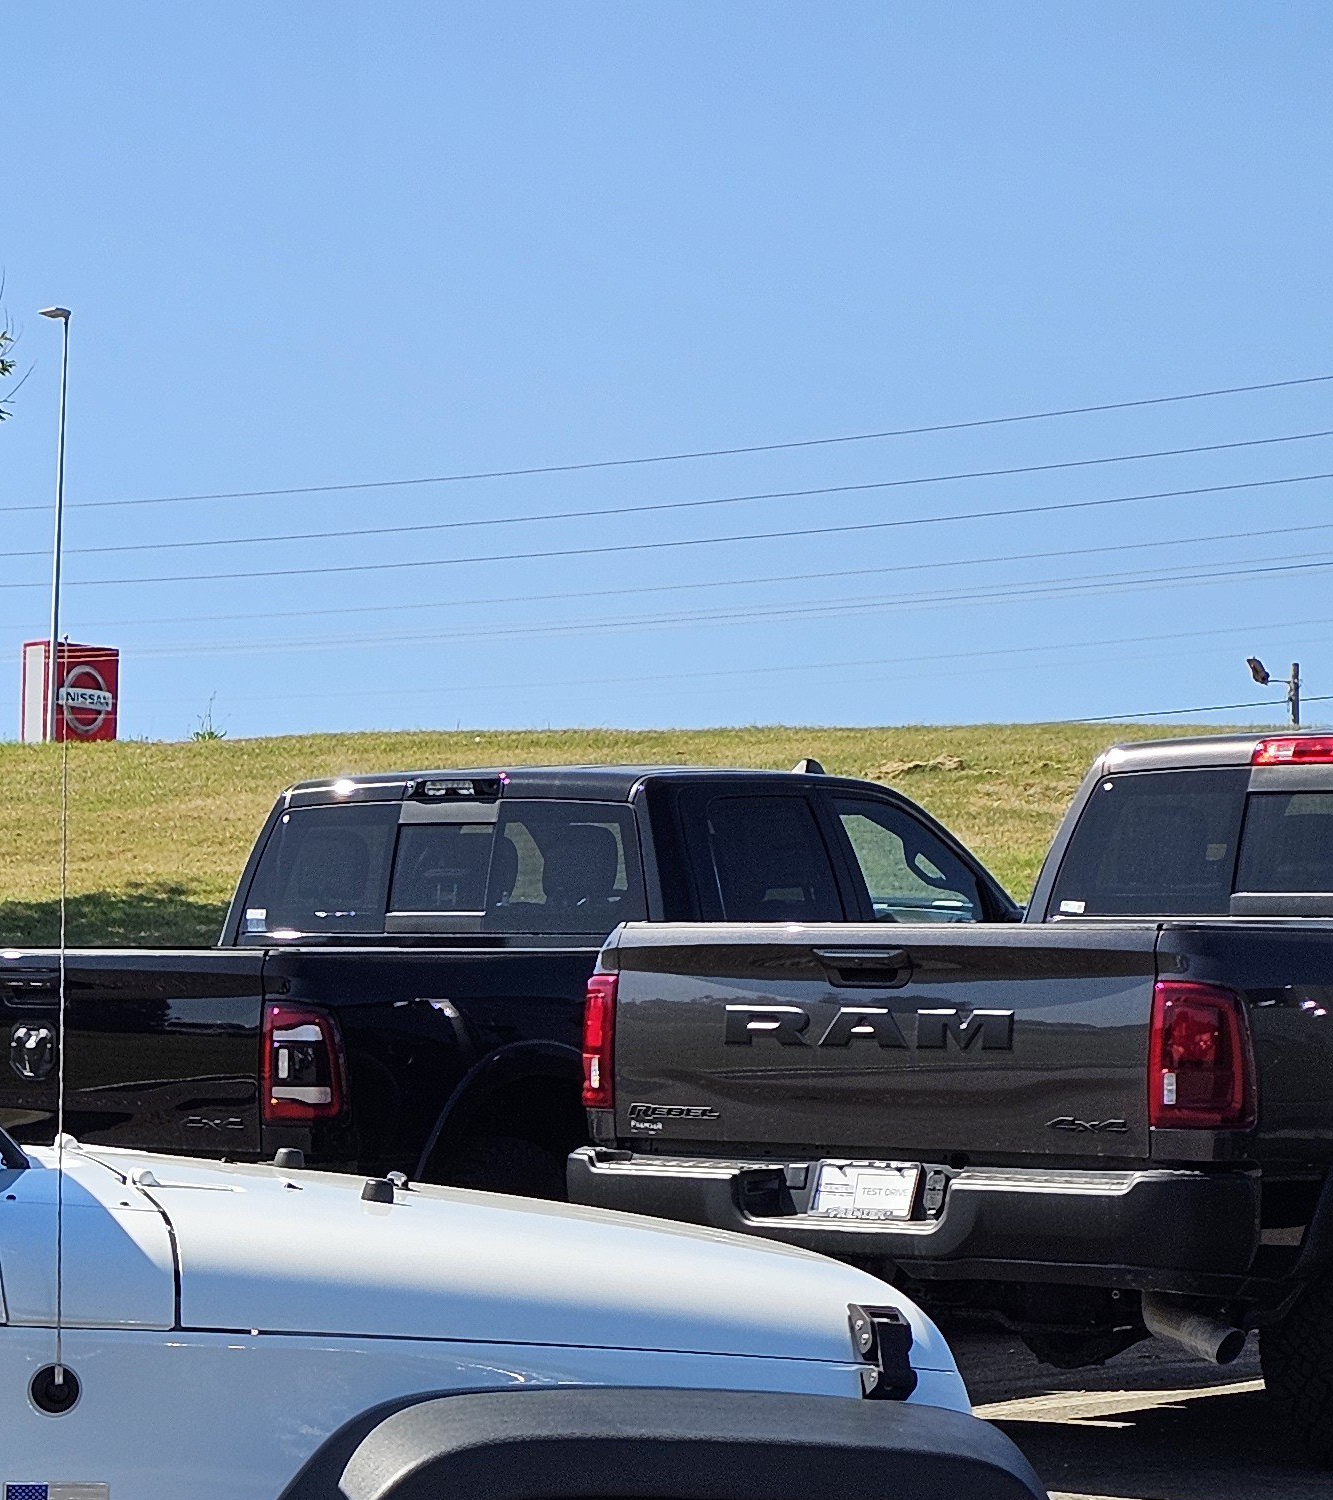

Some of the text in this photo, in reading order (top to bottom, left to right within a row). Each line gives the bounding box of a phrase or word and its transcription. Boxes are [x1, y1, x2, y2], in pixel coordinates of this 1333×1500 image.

[66, 691, 110, 707] NISSAN
[724, 1004, 1015, 1050] RAM
[627, 1102, 721, 1120] REBEL
[862, 1187, 883, 1196] TEST
[884, 1187, 909, 1197] DRIVE
